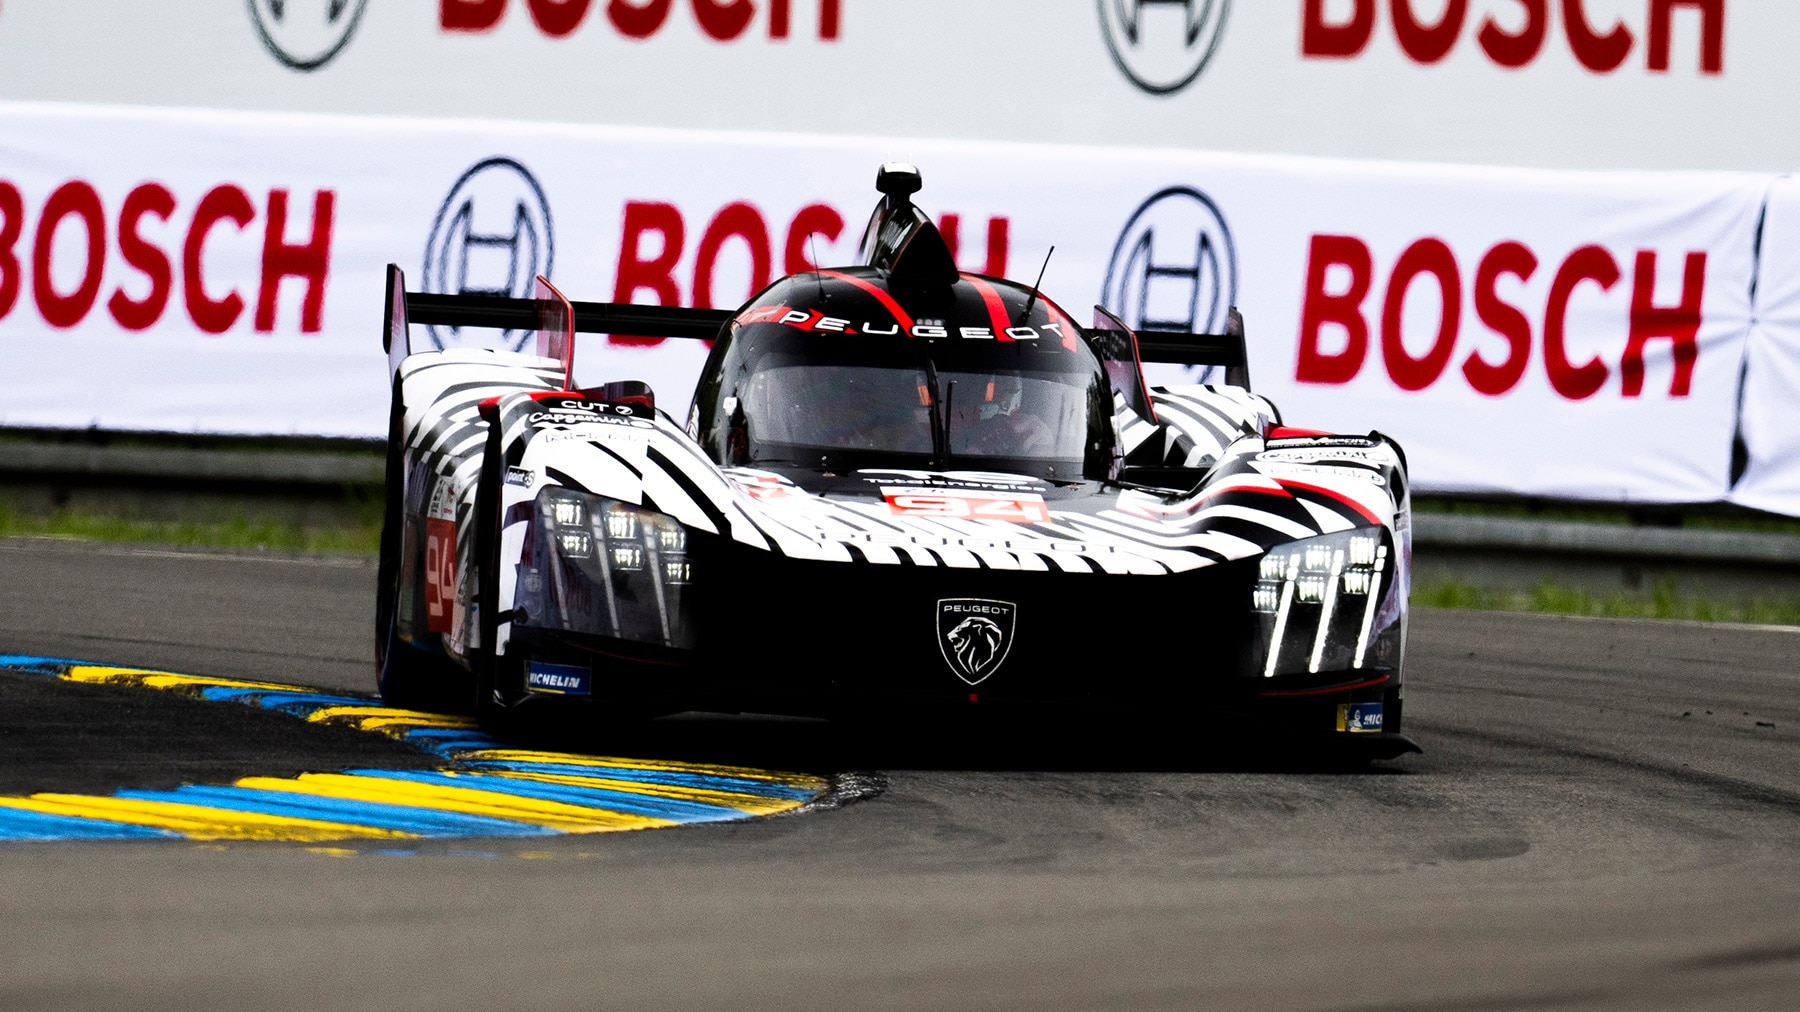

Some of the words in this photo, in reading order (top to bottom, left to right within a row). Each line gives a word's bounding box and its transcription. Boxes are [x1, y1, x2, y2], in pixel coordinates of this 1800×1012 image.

[779, 309, 1064, 341] PEUGEOT
[1295, 233, 1706, 400] BOSCH
[561, 400, 609, 412] CUT
[529, 412, 630, 426] Capgemini
[894, 497, 1043, 521] 94
[427, 535, 456, 617] 94
[944, 605, 1009, 615] PEUGEOT
[529, 672, 581, 688] MICHELIN
